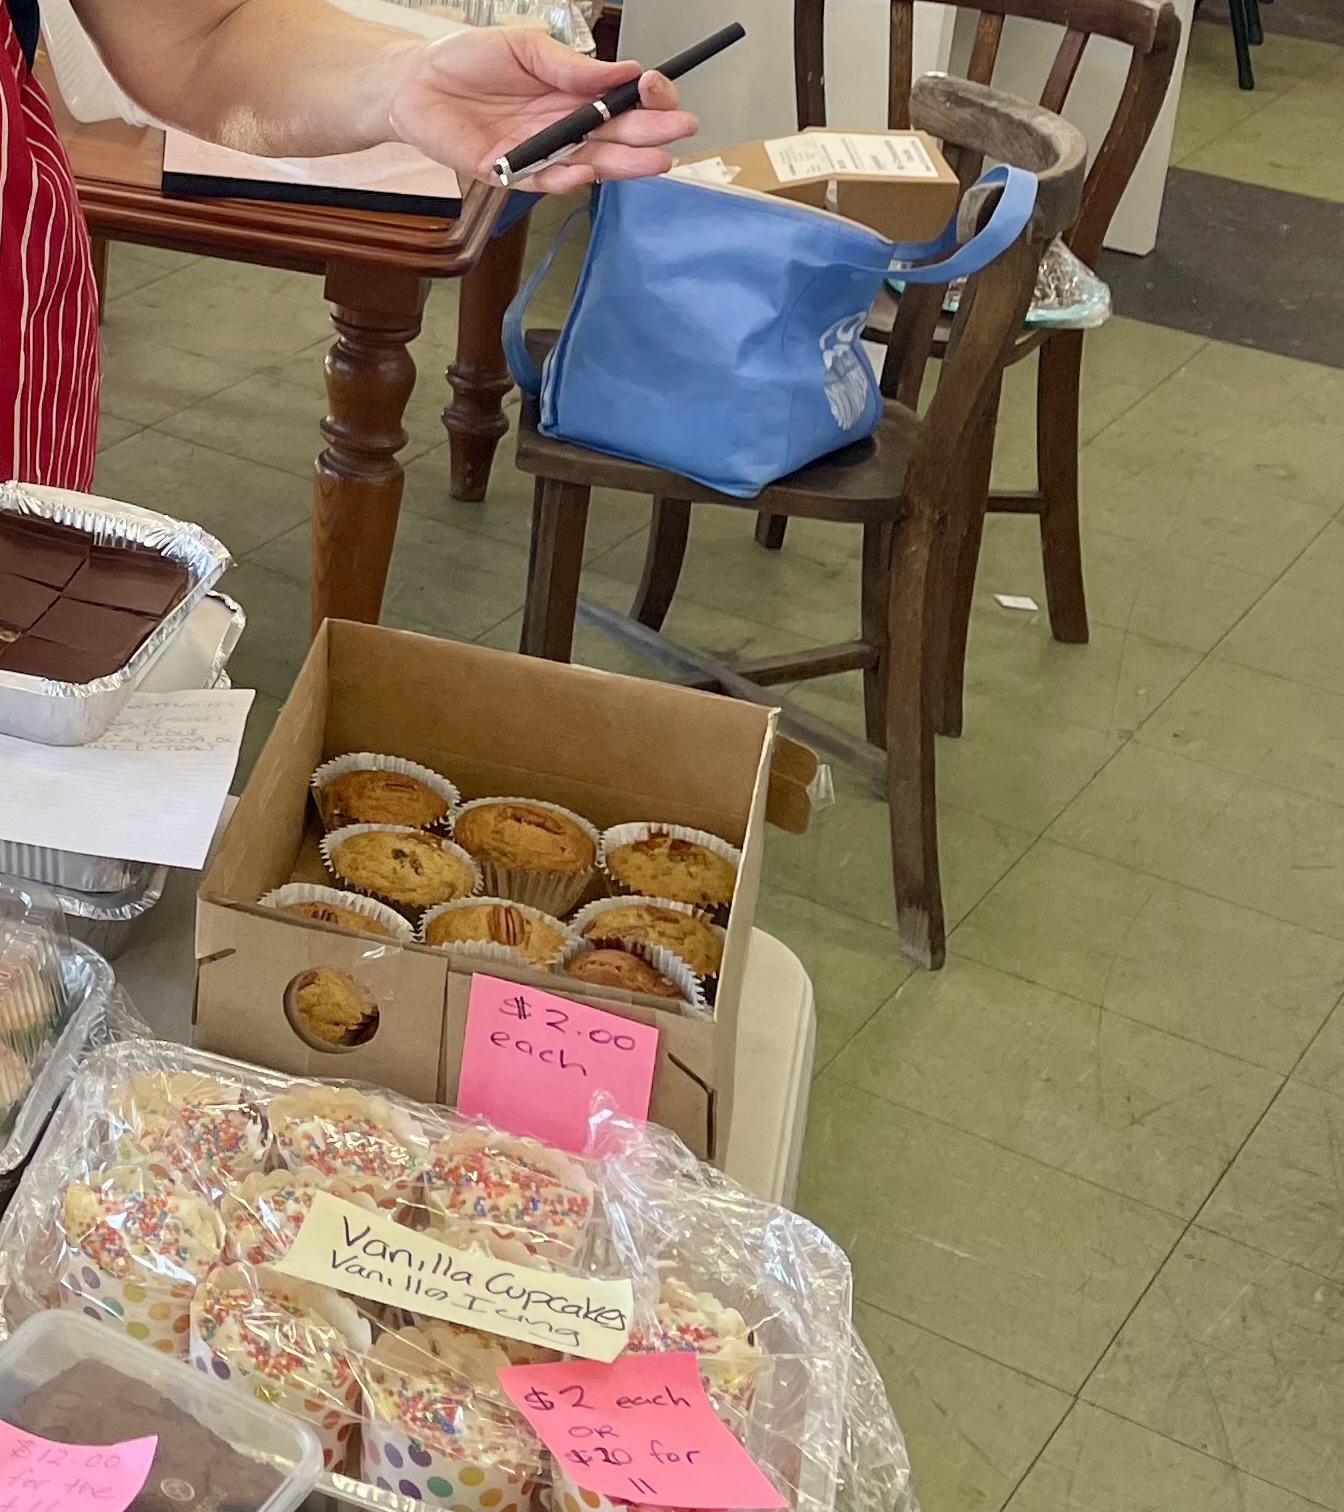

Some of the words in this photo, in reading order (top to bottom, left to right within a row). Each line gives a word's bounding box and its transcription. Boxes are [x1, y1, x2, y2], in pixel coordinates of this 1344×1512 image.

[489, 1030, 588, 1077] each
[330, 1249, 448, 1301] Vanilla
[342, 1215, 474, 1285] Vanilla
[484, 1271, 628, 1332] Cupcakes
[523, 1386, 593, 1411] $2
[615, 1387, 691, 1410] each
[568, 1425, 620, 1439] OR
[649, 1439, 701, 1465] for
[8, 1467, 50, 1491] for
[63, 1477, 115, 1500] the
